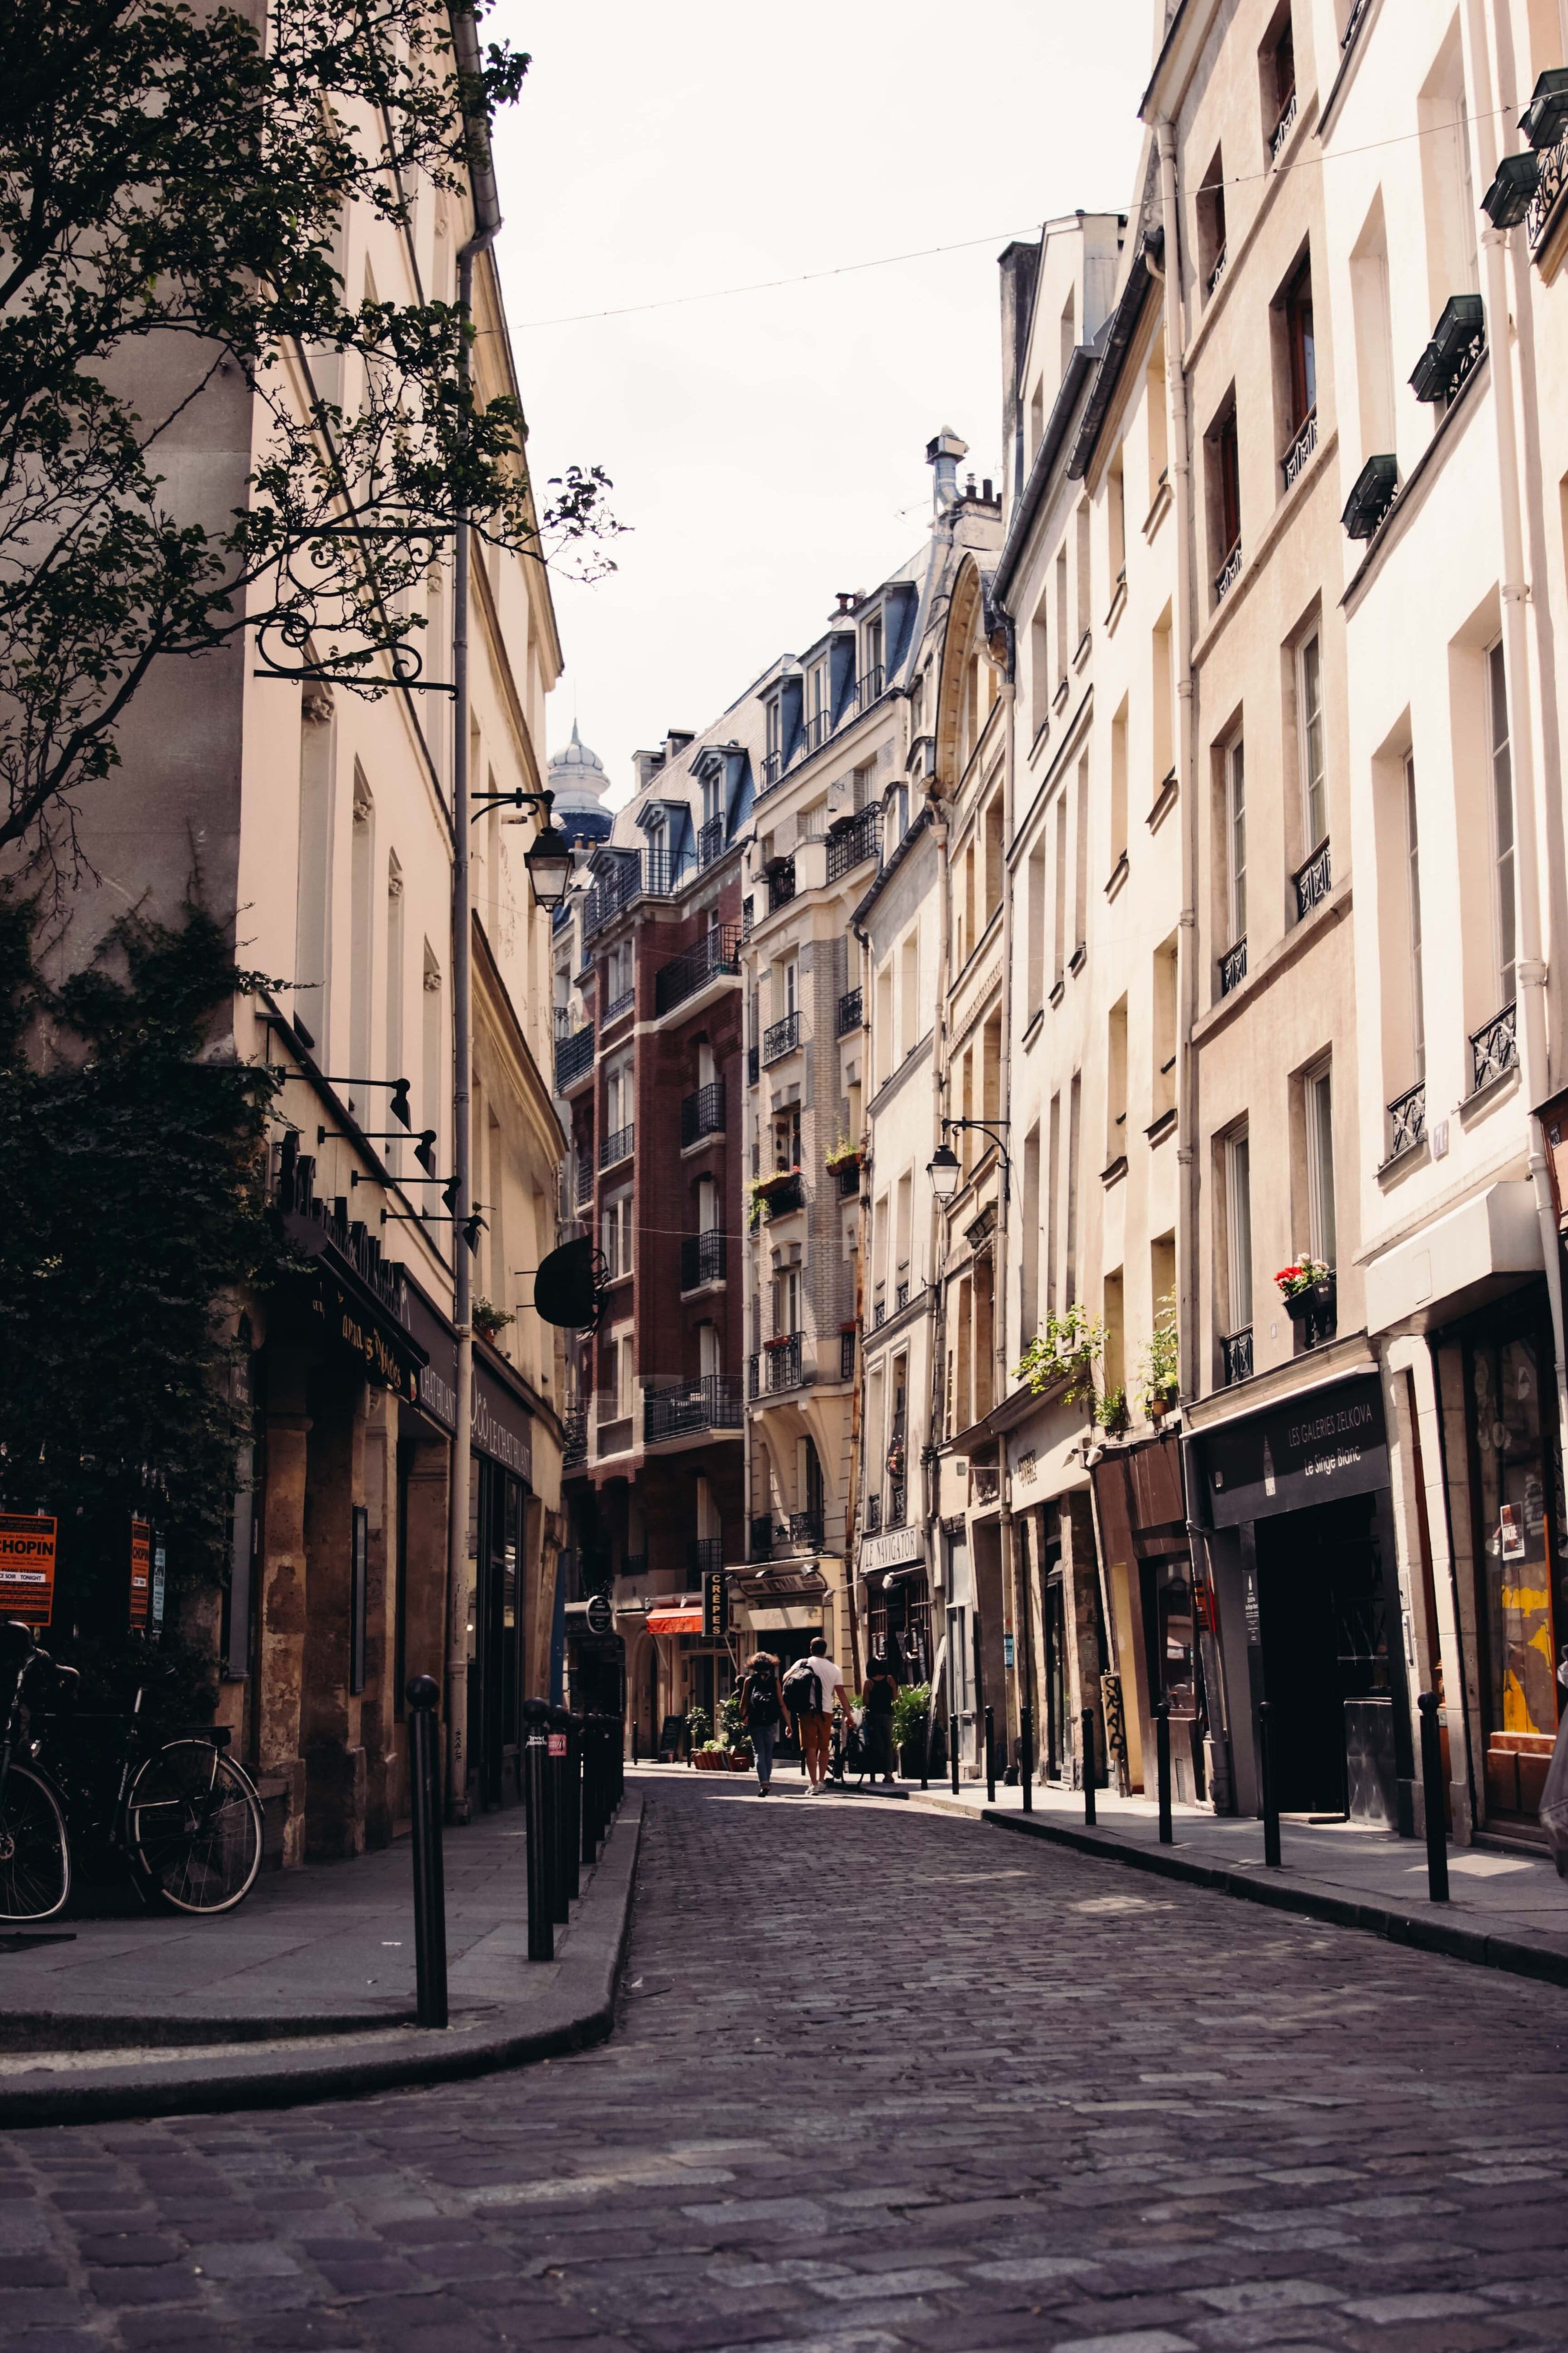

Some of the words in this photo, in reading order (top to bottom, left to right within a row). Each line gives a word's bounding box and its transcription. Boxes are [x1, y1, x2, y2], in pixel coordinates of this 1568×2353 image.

[489, 1418, 497, 1455] LE
[498, 1424, 513, 1466] CHAT
[1288, 1426, 1300, 1447] LES
[1301, 1414, 1335, 1443] GALERIES
[1336, 1403, 1373, 1432] ZELKOVA
[1304, 1458, 1313, 1476] Le
[1314, 1452, 1336, 1475] Singe
[1337, 1446, 1361, 1467] Blanc
[0, 1539, 54, 1556] HOPIN
[865, 1543, 873, 1567] LE
[877, 1531, 915, 1565] NAVIGATOR
[711, 1574, 721, 1634] CRÊPES
